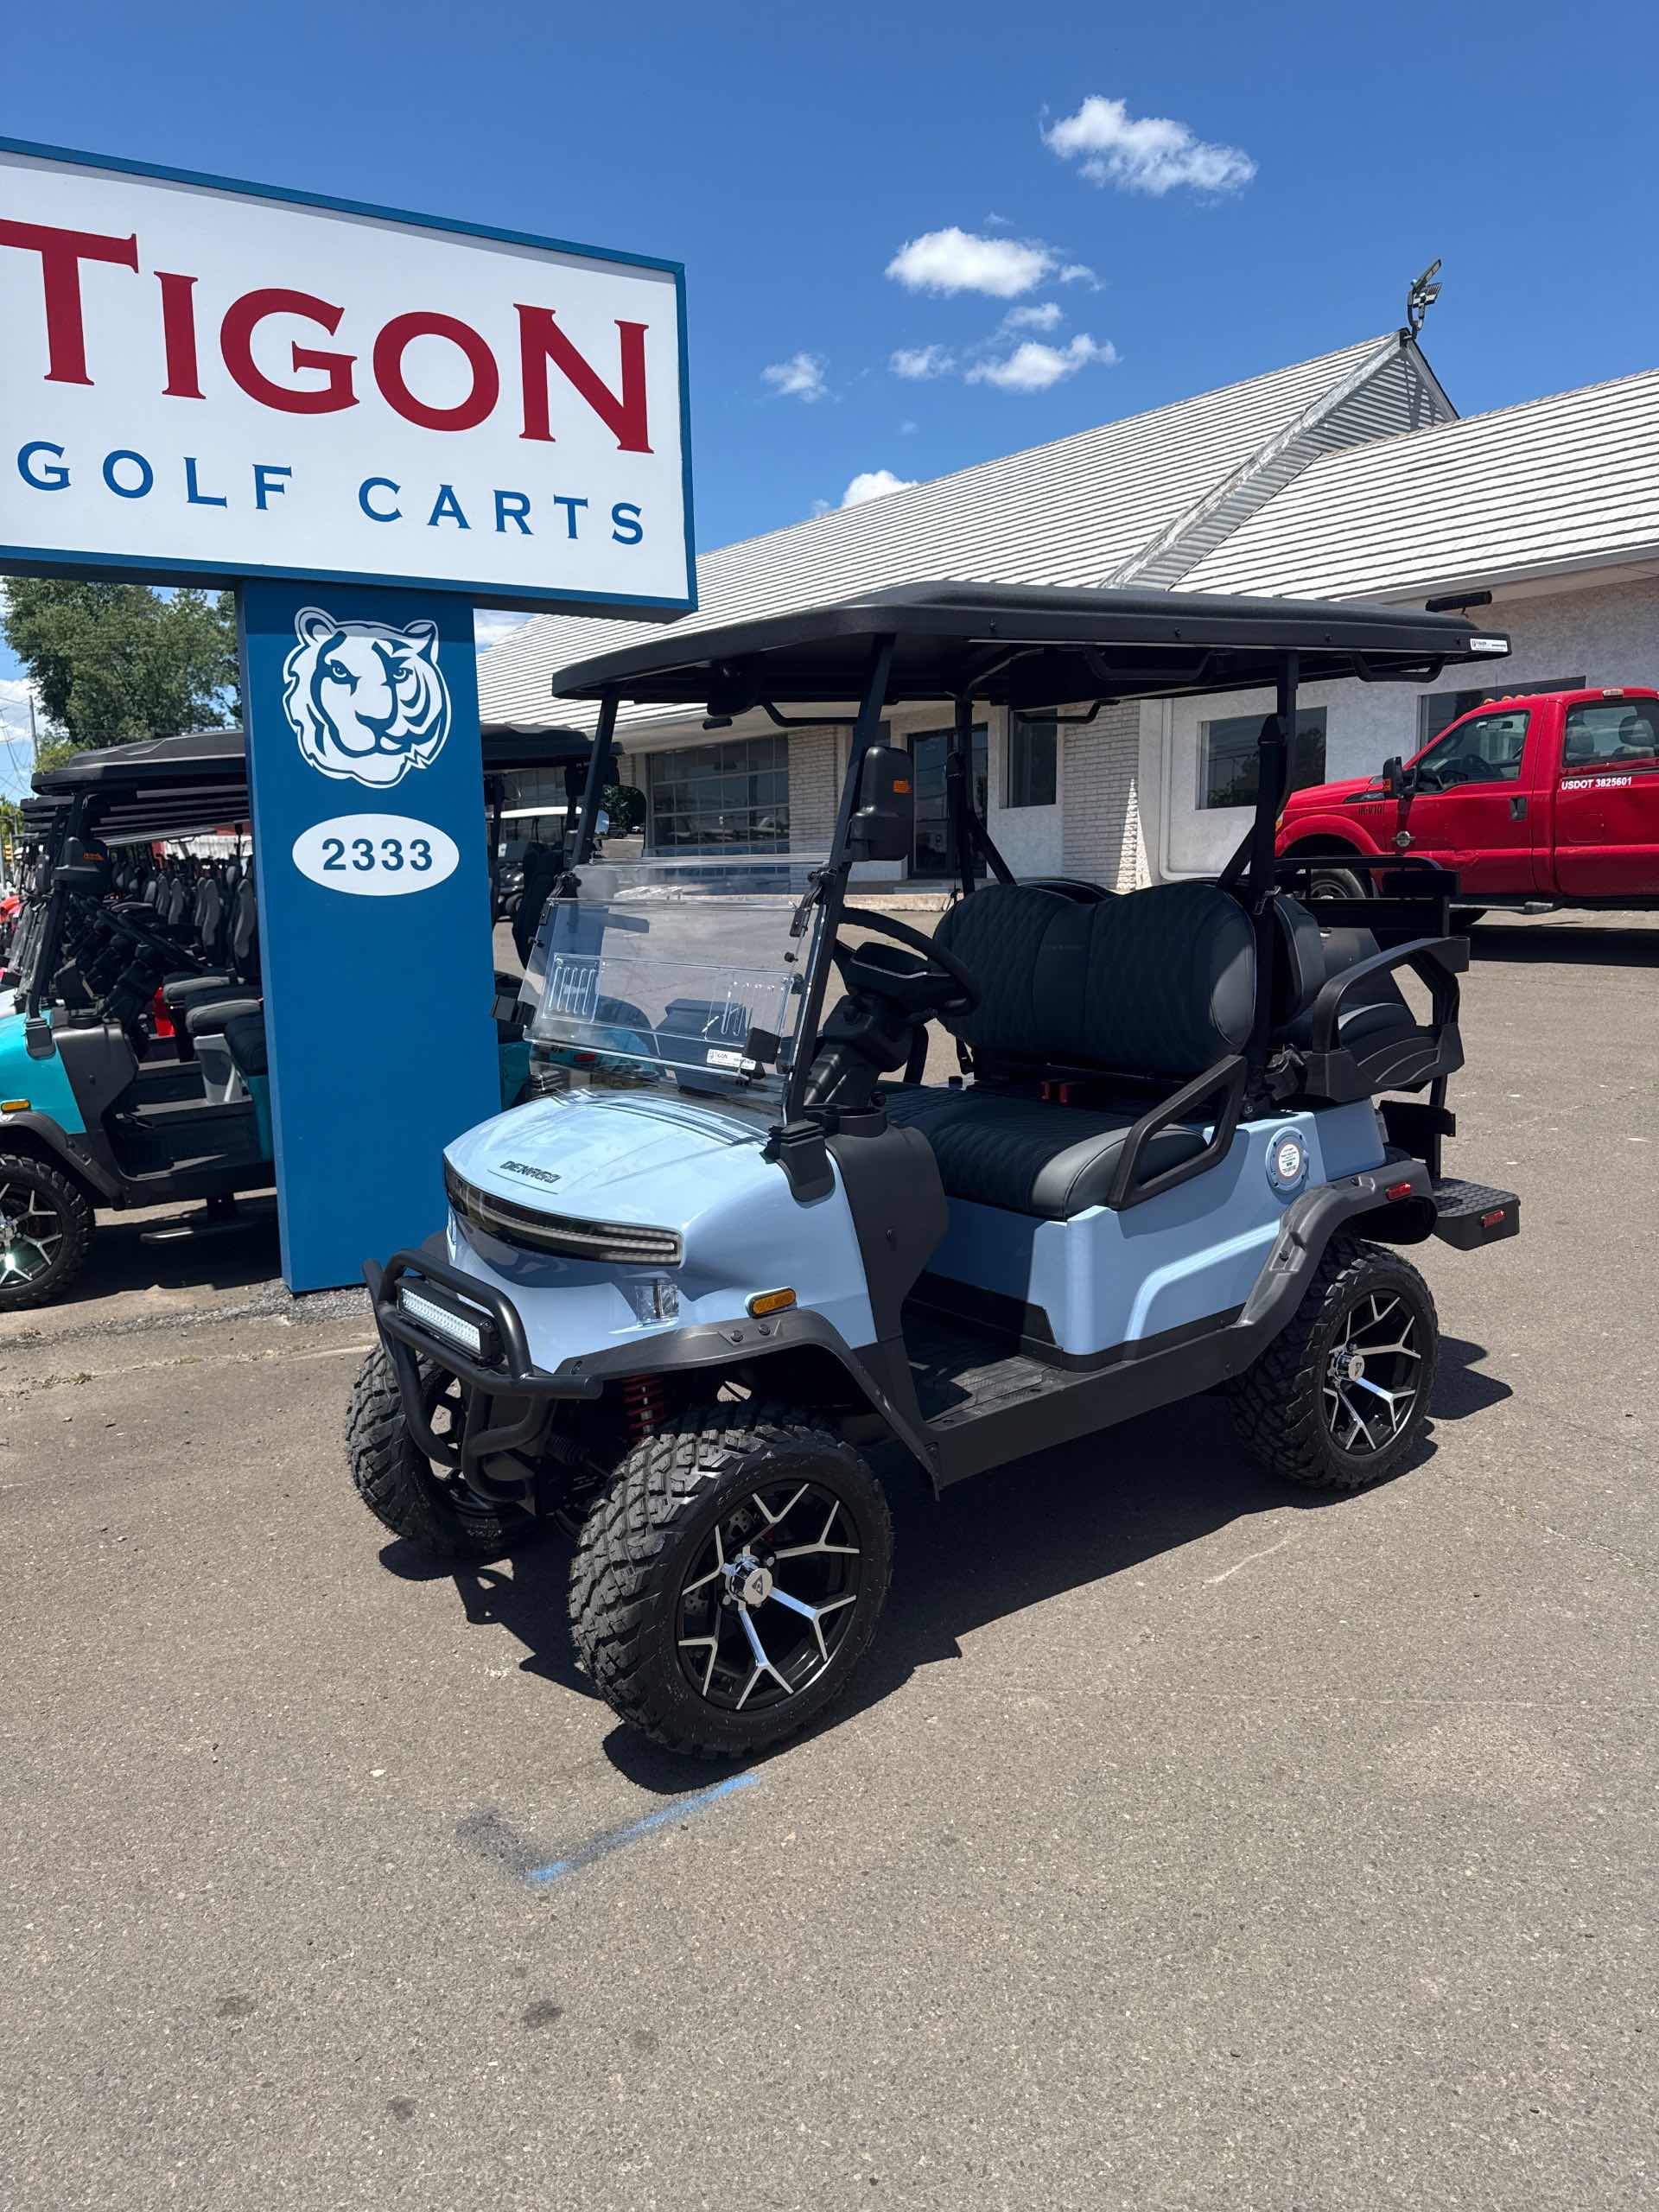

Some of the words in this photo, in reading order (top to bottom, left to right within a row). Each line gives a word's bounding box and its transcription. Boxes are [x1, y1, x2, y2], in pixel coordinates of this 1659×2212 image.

[0, 219, 654, 454] TIGON
[17, 442, 292, 510] GOLF
[359, 477, 643, 544] CARTS
[1561, 780, 1594, 790] USDOT
[1595, 777, 1631, 787] 3825601
[322, 838, 432, 871] 2333
